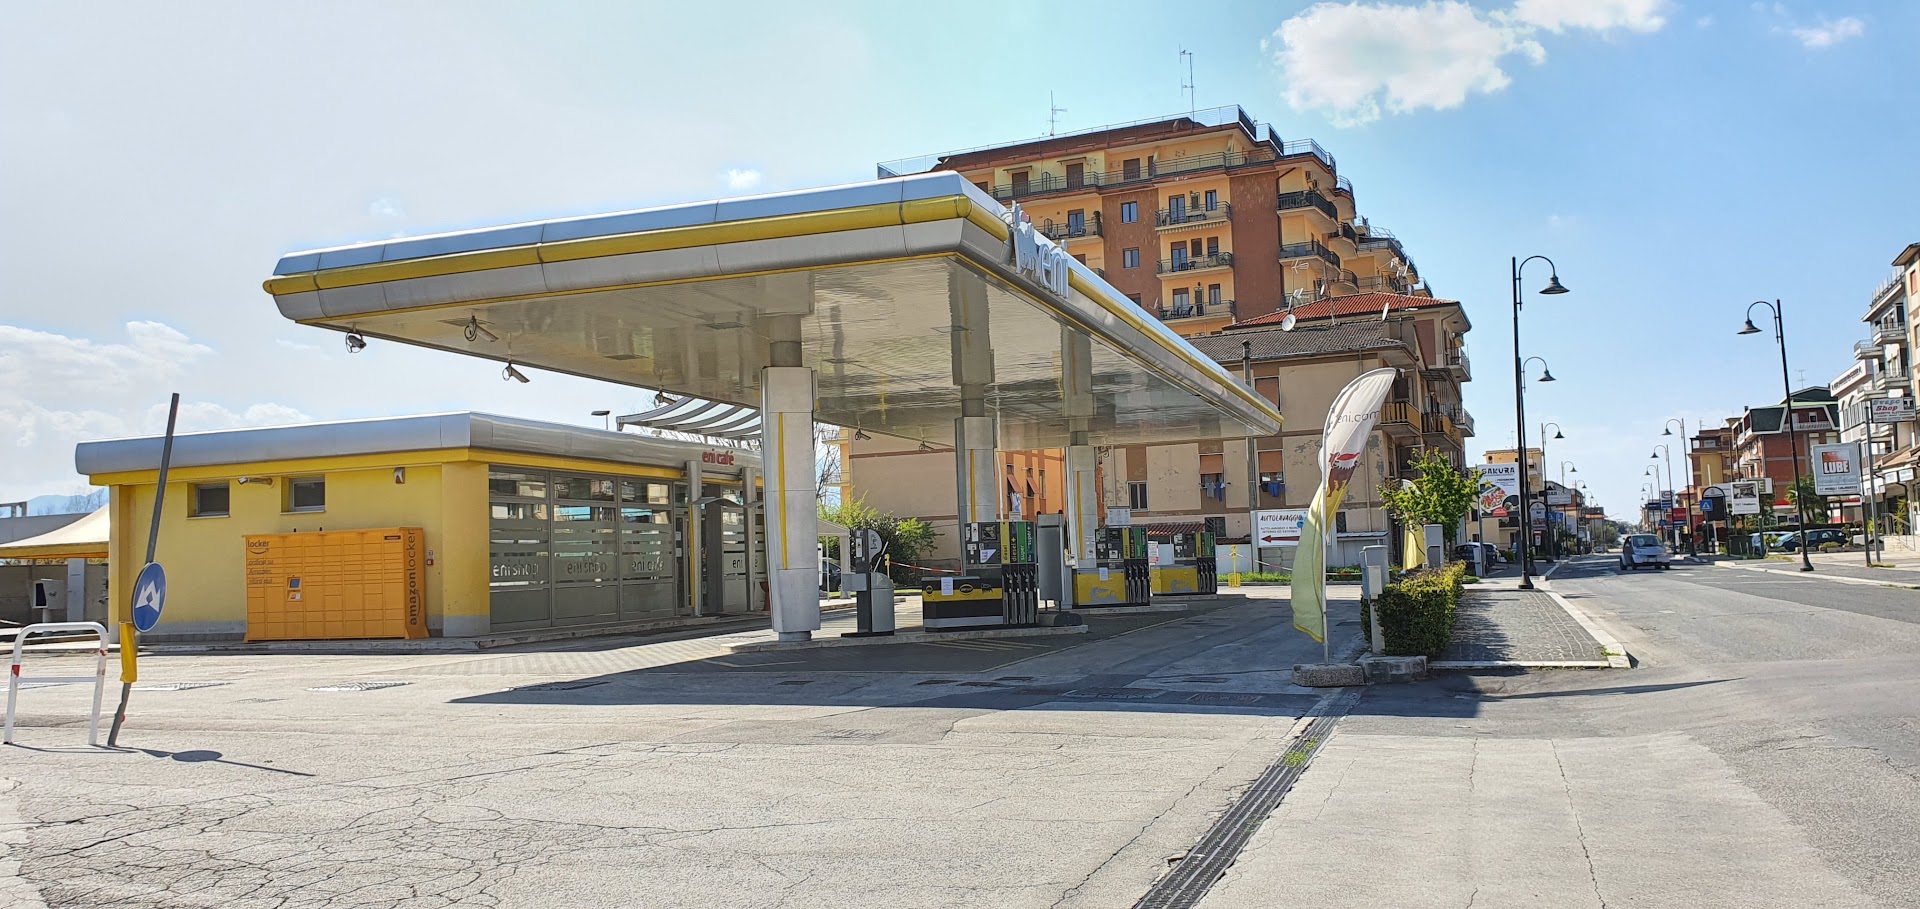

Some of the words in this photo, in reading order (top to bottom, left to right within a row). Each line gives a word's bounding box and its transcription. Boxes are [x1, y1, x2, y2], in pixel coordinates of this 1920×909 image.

[1039, 240, 1069, 299] eni
[1336, 410, 1380, 423] eni.com
[702, 448, 715, 464] eni
[717, 450, 735, 466] café
[1481, 467, 1515, 475] SAKURA
[1823, 460, 1849, 474] LUBE
[1260, 514, 1303, 523] AUTOLAVAGGIO
[247, 540, 270, 548] locker
[493, 559, 511, 577] eni
[567, 561, 583, 575] eni
[583, 560, 607, 575] shop
[631, 558, 645, 572] eni
